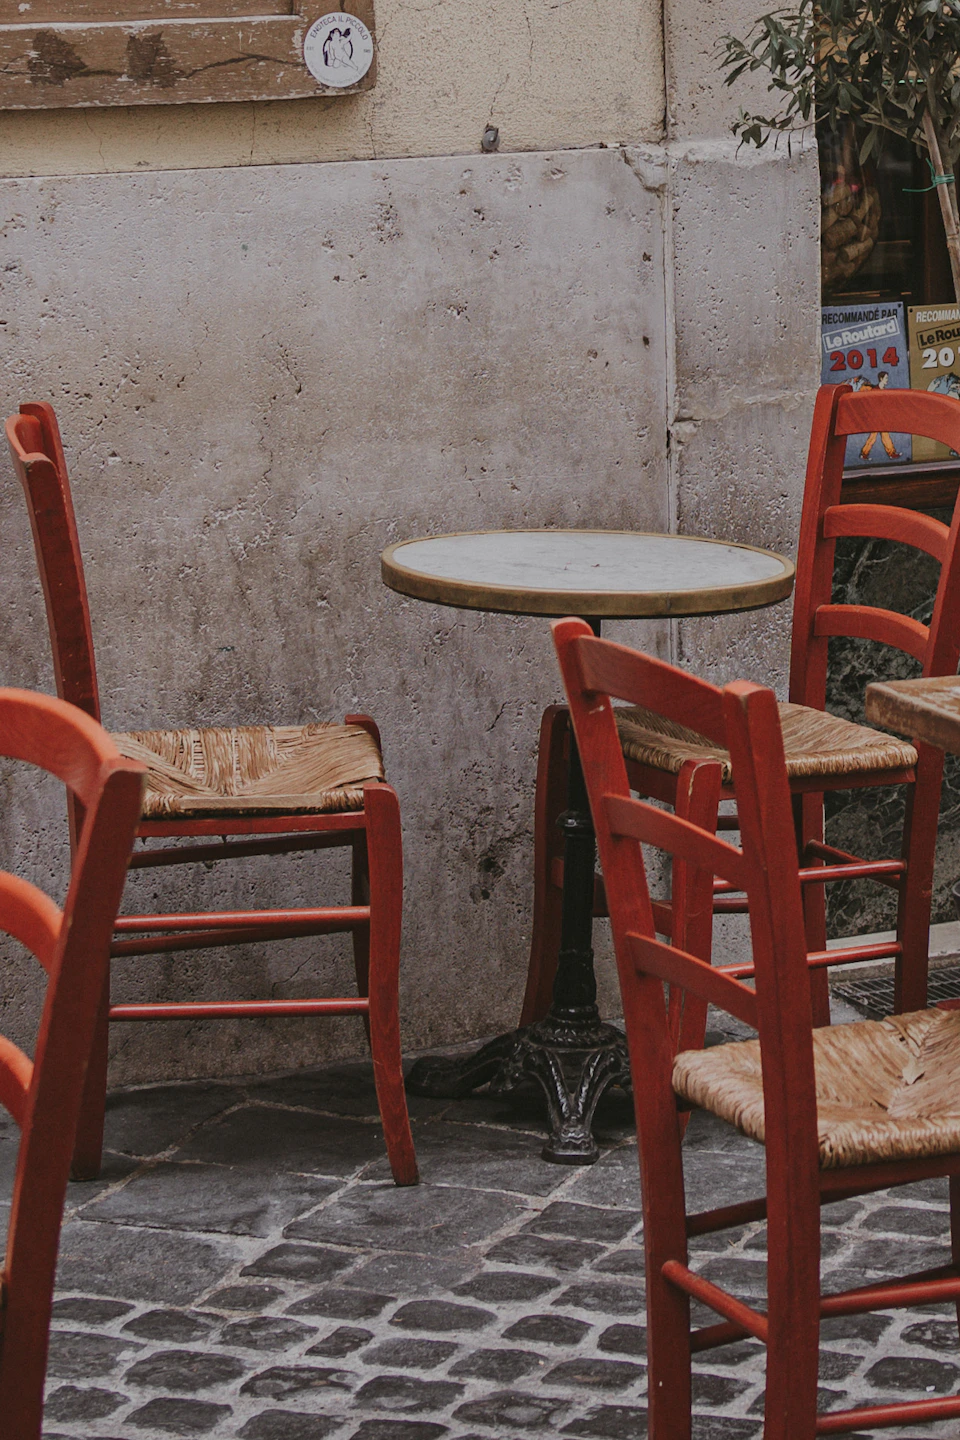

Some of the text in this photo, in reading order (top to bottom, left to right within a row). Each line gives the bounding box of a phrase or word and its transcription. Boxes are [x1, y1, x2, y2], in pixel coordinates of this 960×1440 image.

[310, 15, 336, 39] ENOTECA
[345, 16, 369, 41] PICCOLO
[822, 306, 898, 325] RECOMMANDÉ PAR
[829, 346, 900, 371] 2014
